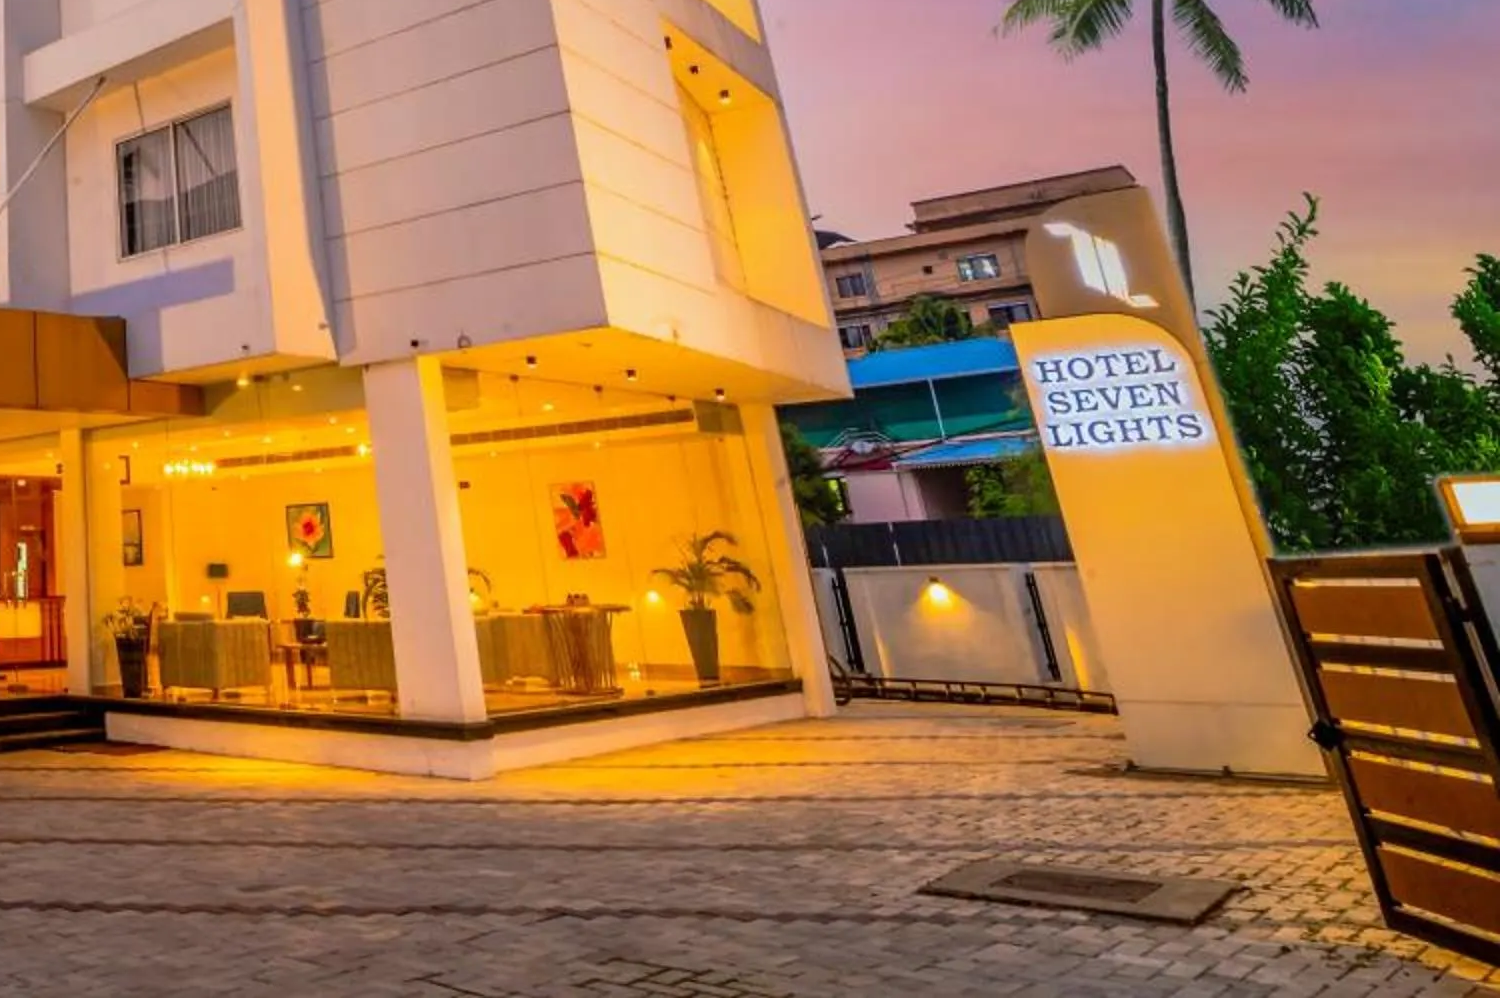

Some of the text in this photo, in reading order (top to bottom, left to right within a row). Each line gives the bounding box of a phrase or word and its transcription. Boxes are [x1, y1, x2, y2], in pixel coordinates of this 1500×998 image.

[1036, 349, 1175, 383] HOTEL
[1048, 381, 1182, 415] SEVEN
[1048, 414, 1202, 446] LIGHTS
